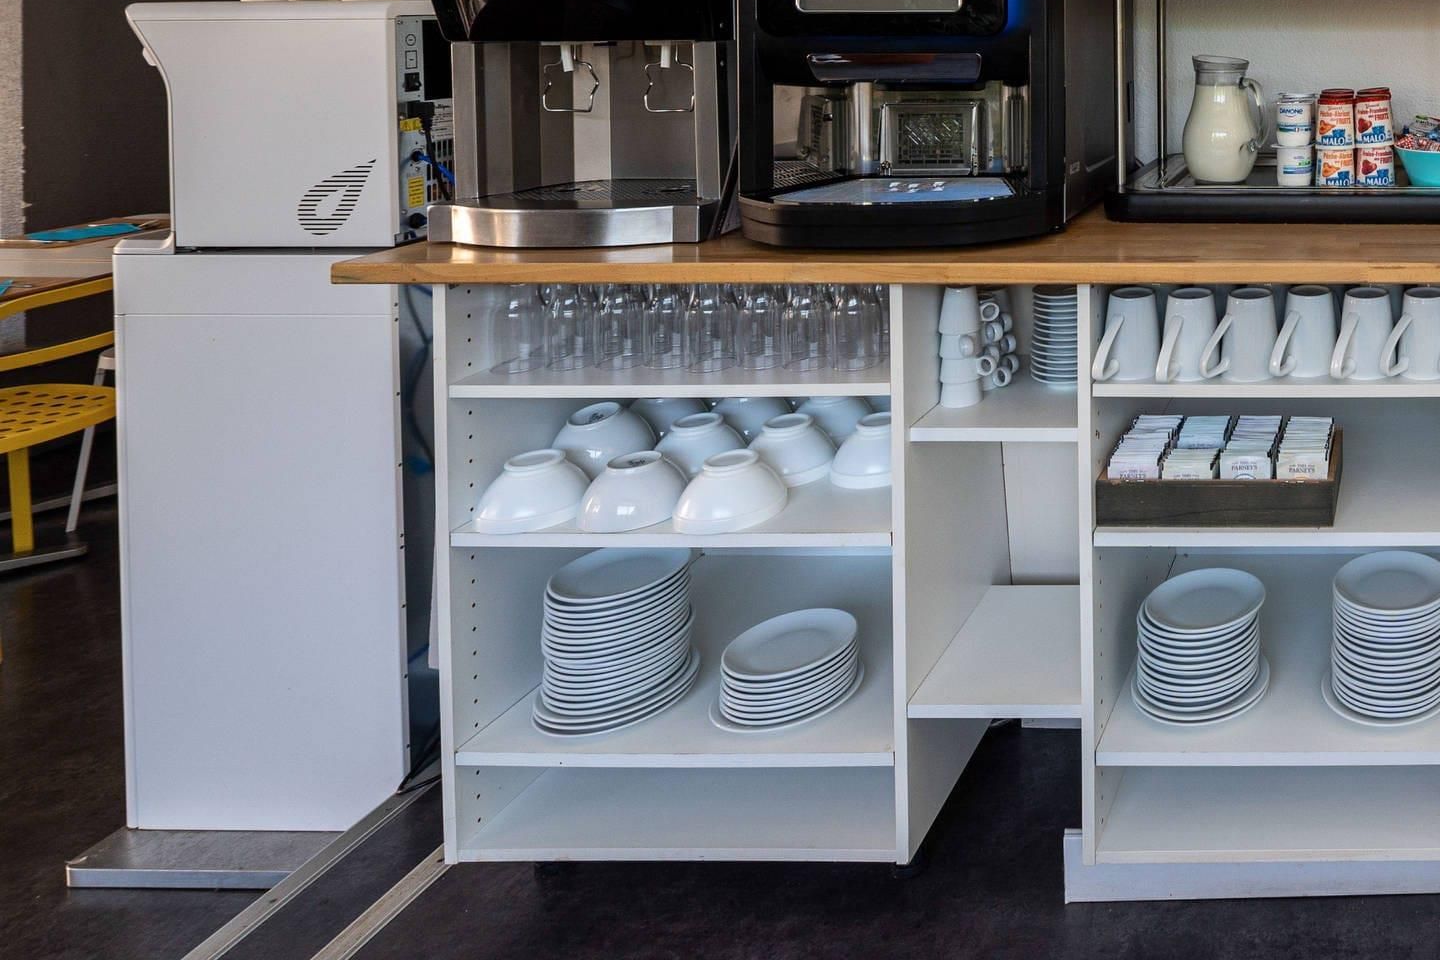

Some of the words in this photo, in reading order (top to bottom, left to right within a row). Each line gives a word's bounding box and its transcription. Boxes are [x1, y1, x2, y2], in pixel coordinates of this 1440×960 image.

[1322, 137, 1345, 146] MALO
[1363, 133, 1385, 143] MALO
[1327, 178, 1350, 187] MALO
[1366, 176, 1389, 186] MALO
